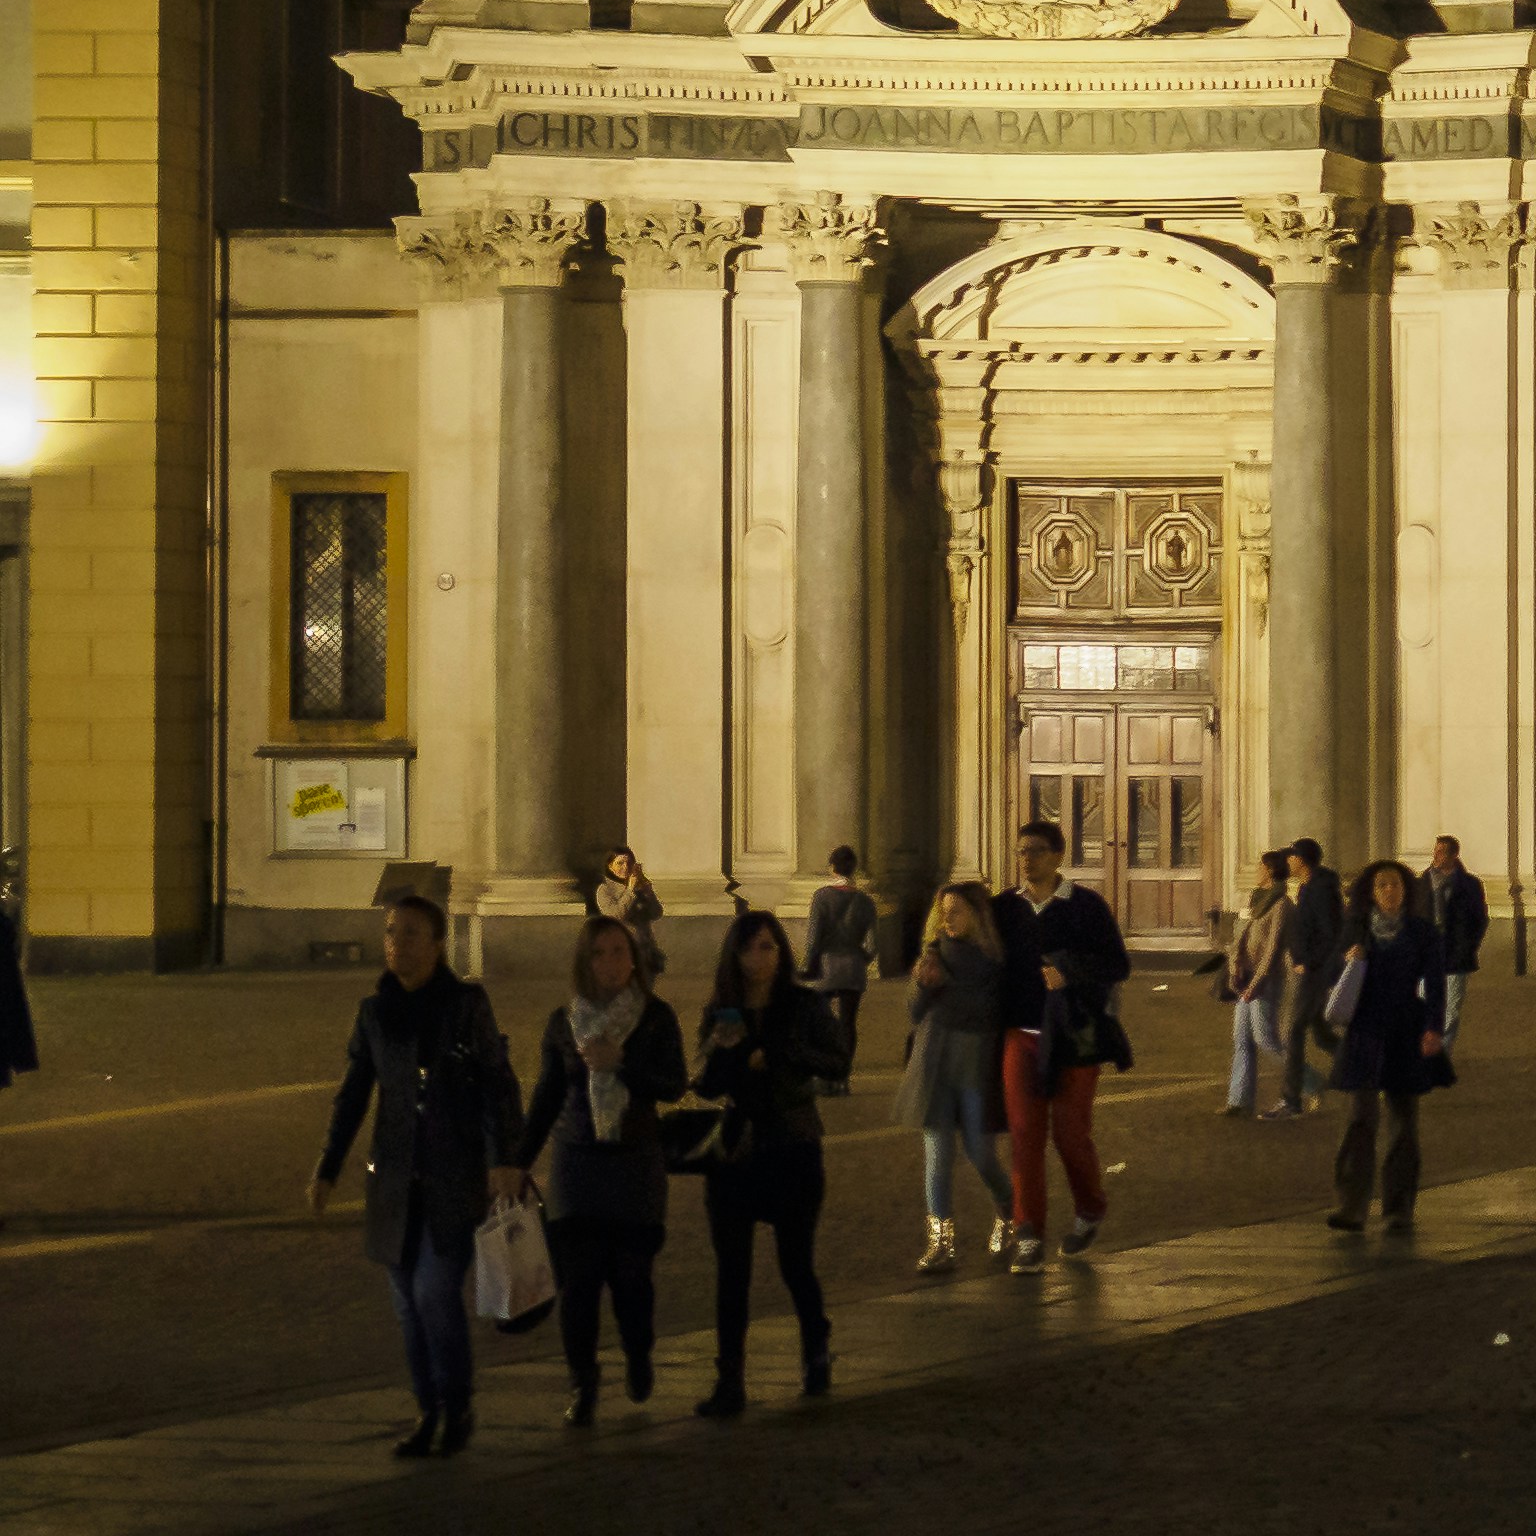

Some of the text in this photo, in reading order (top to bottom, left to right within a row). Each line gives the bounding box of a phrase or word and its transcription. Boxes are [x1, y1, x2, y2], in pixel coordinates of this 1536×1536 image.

[804, 107, 984, 145] JOANNA
[1000, 109, 1194, 146] BAPTISTA
[1201, 107, 1317, 146] REGIS
